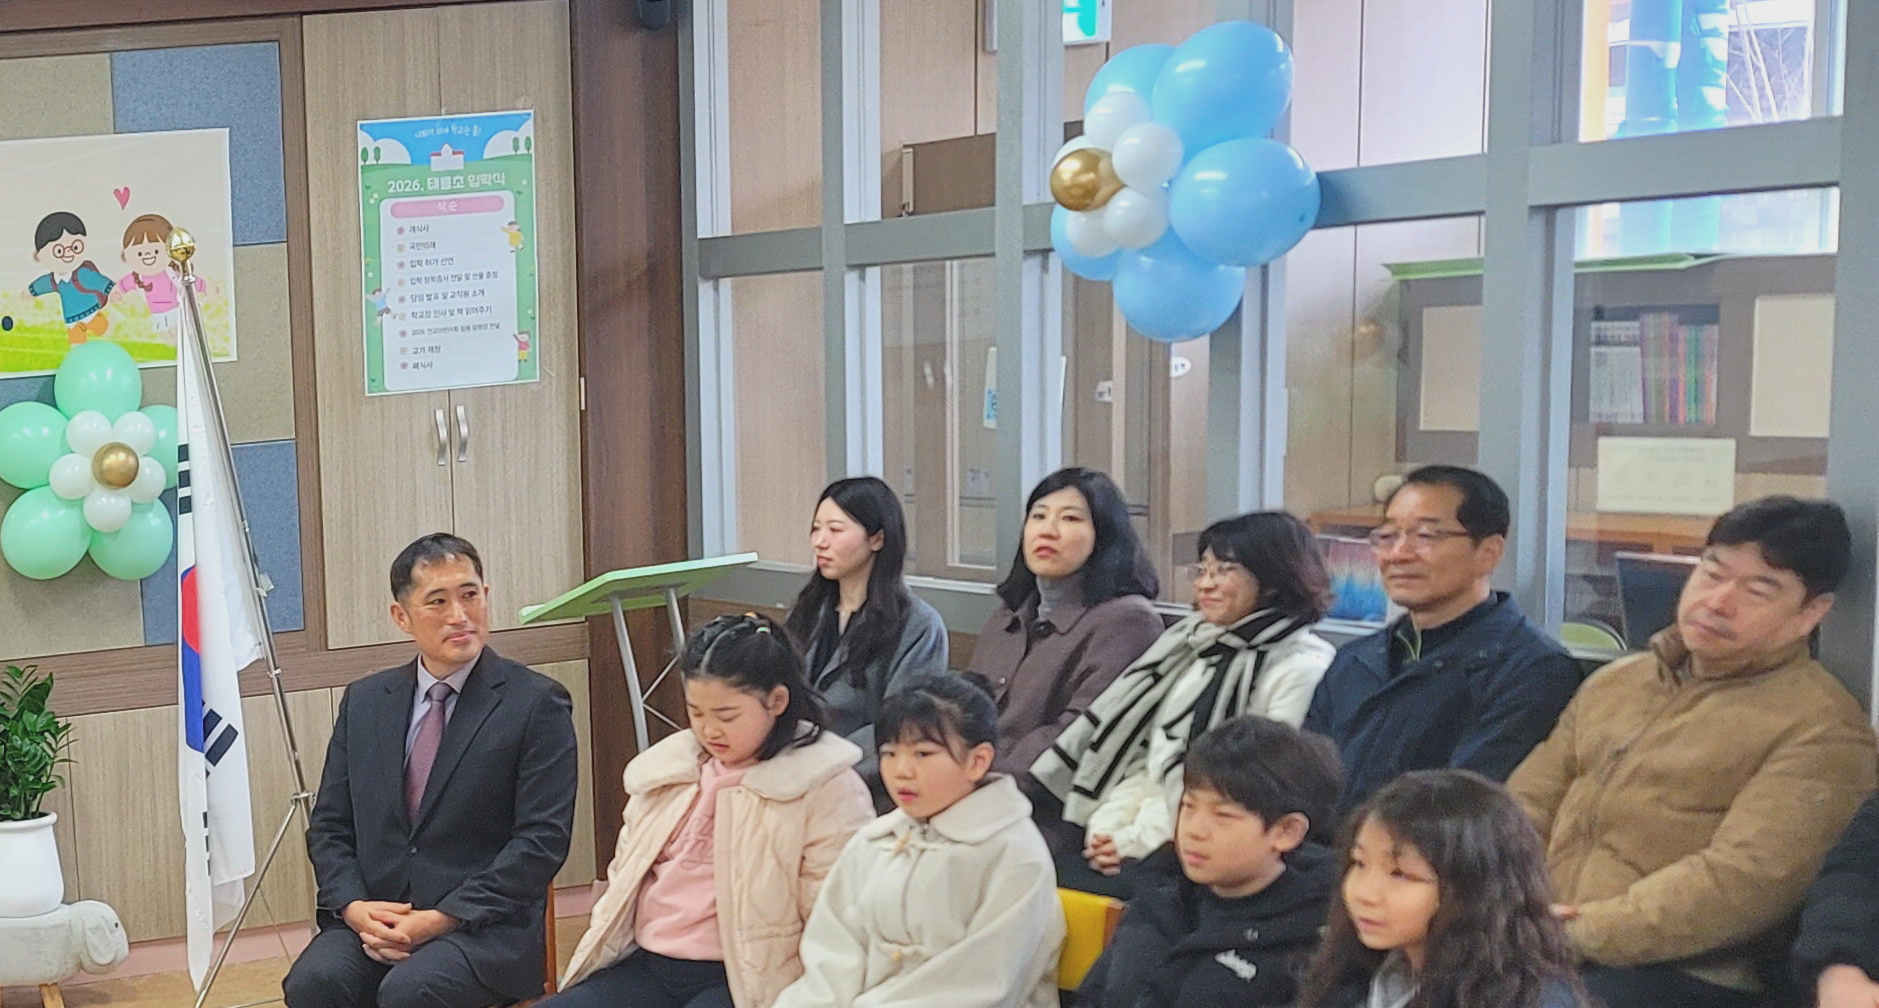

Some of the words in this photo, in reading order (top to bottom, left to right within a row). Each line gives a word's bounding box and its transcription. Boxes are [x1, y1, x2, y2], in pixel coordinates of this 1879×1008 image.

[387, 178, 424, 193] 2026.
[427, 175, 465, 190] 태룡초
[467, 172, 506, 188] 입학식
[409, 224, 430, 234] 개식사
[409, 241, 436, 251] 국민의례
[409, 259, 423, 269] 입학
[425, 258, 439, 267] 허가
[440, 257, 454, 267] 선언
[409, 277, 423, 286] 입학
[410, 294, 424, 303] 담임
[426, 292, 440, 301] 발표
[441, 291, 448, 300] 및
[449, 290, 470, 299] 교직원
[471, 288, 485, 298] 소개
[411, 310, 431, 320] 학교장
[433, 309, 447, 318] 인사
[448, 308, 455, 317] 및
[456, 307, 463, 316] 책
[465, 305, 492, 316] 읽어주기
[412, 346, 426, 355] 교가
[427, 345, 441, 354] 제창
[412, 361, 433, 369] 폐식사
